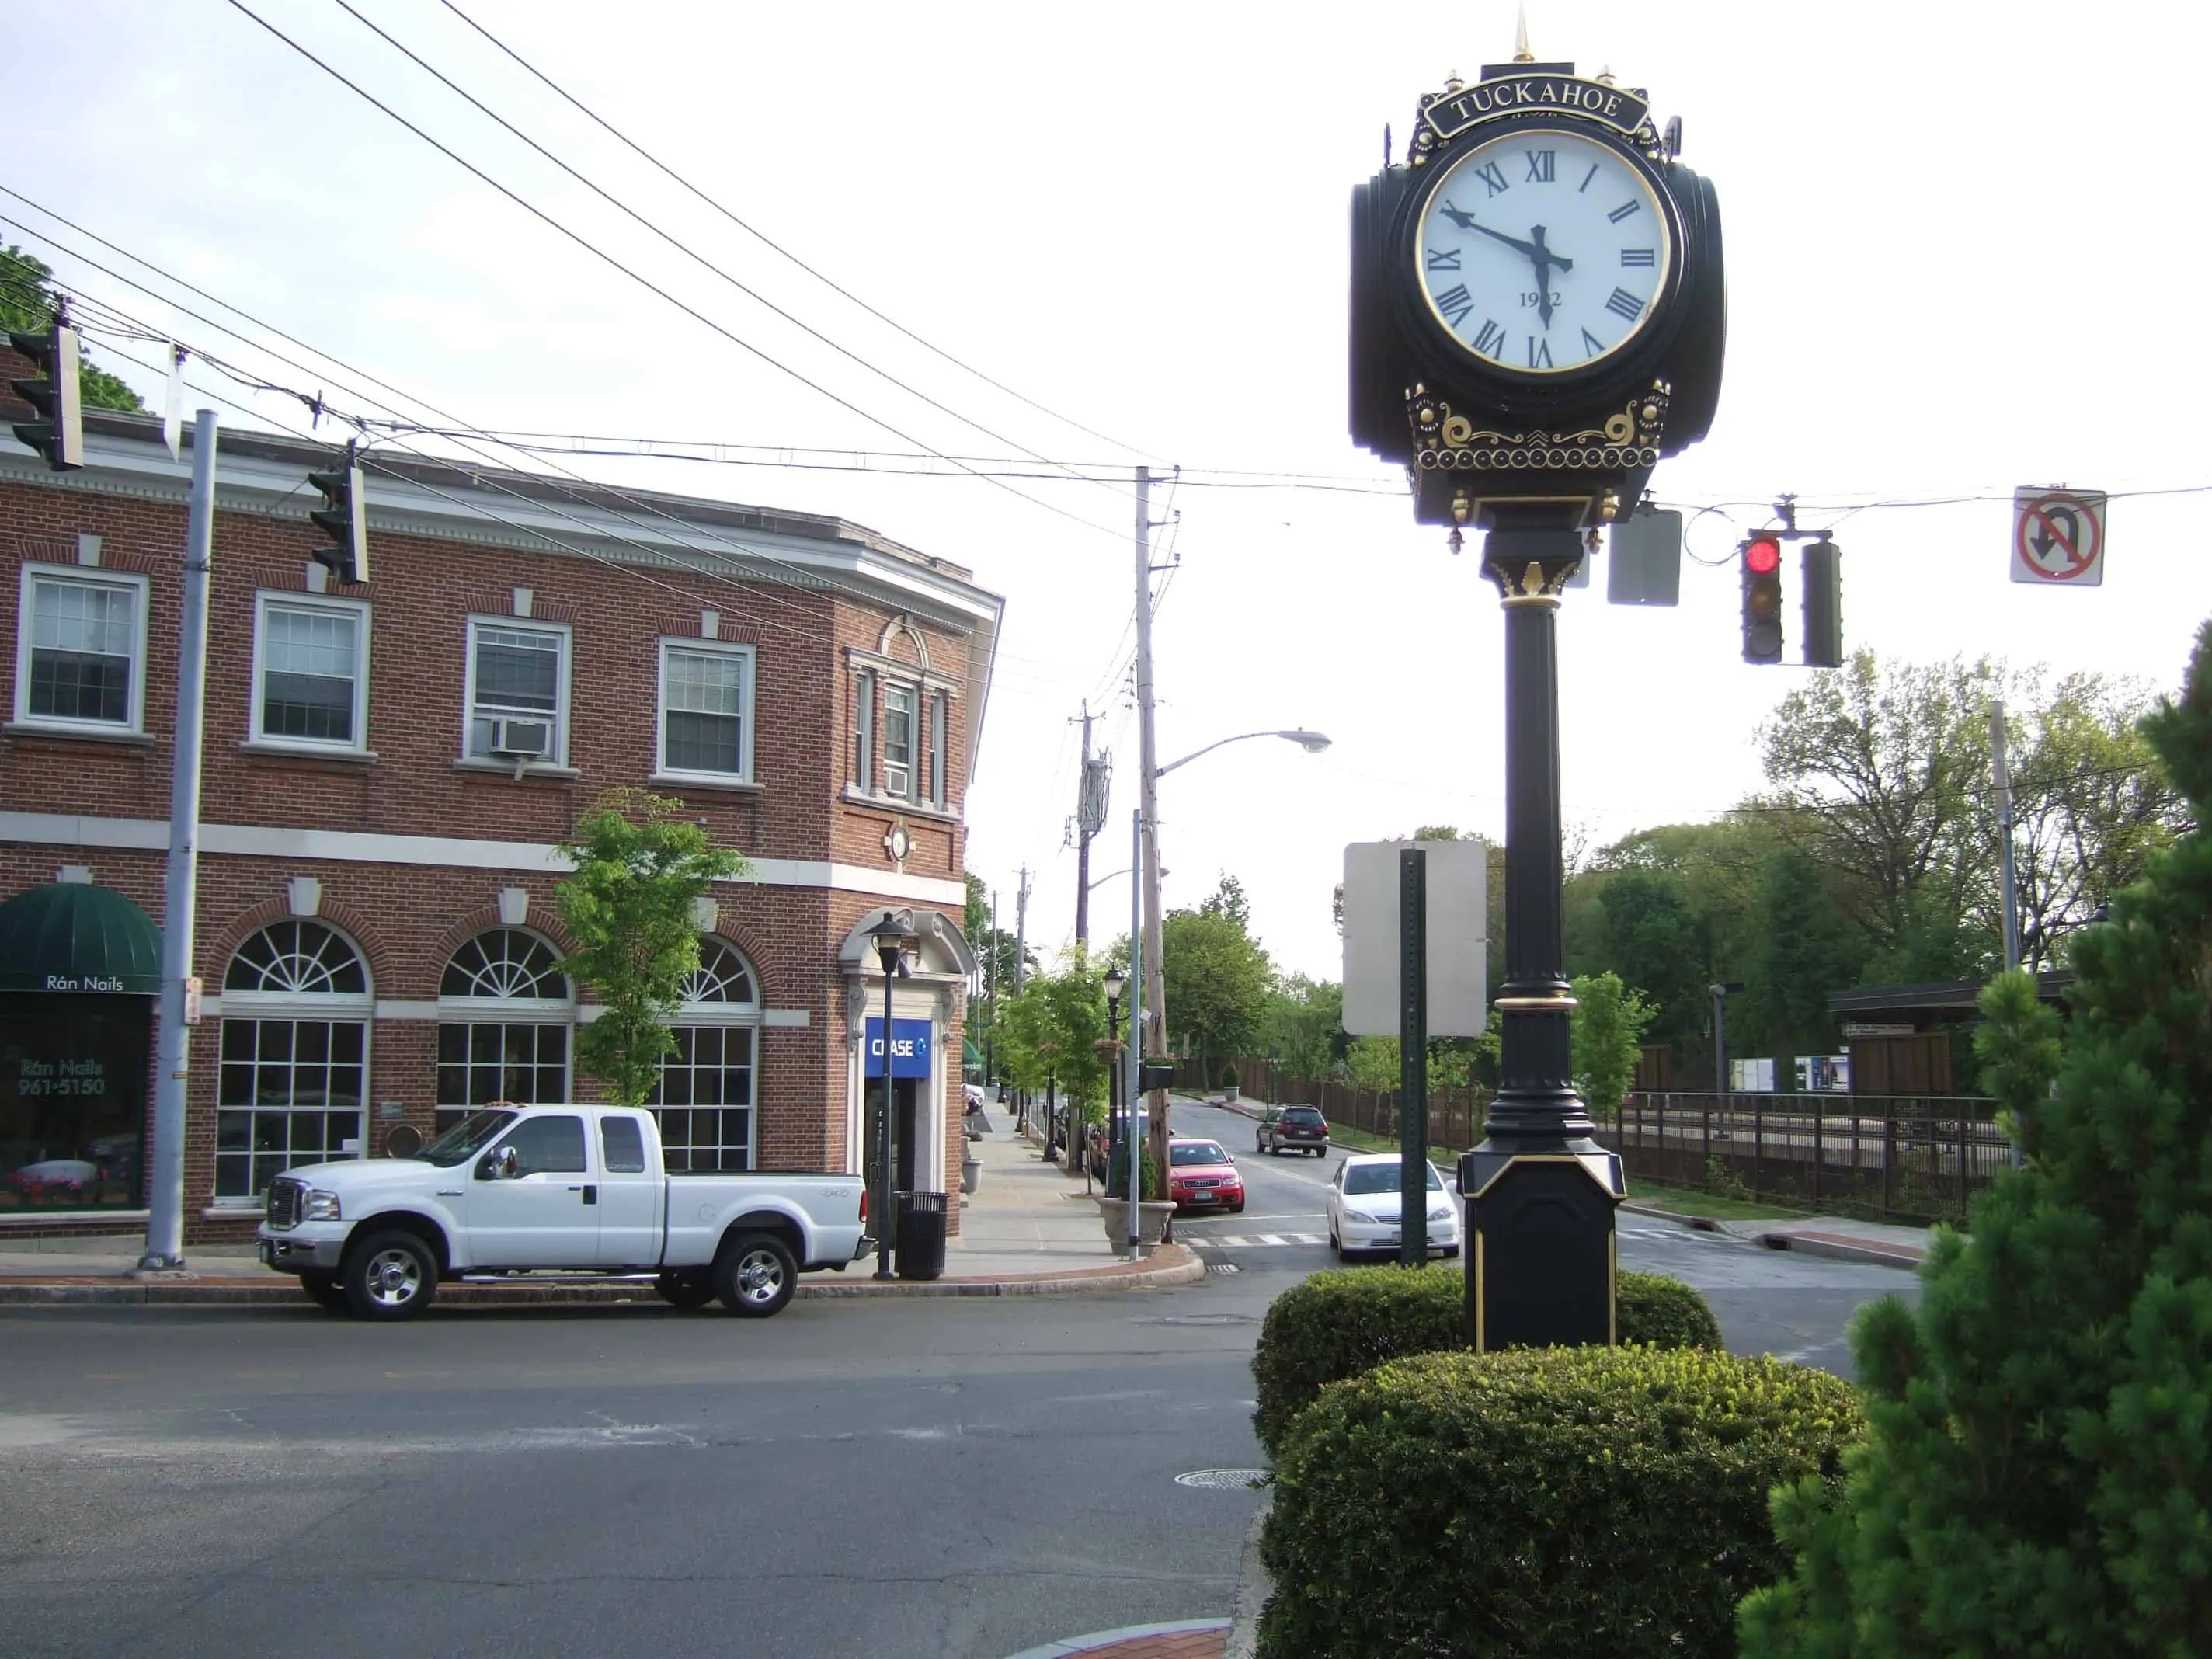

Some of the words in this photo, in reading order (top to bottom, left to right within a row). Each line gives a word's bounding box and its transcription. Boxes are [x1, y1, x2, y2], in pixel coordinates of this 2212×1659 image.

[1450, 82, 1622, 119] TUCKAHOE
[1474, 161, 1510, 198] XI
[1525, 150, 1555, 183] XII
[1608, 199, 1640, 224] II
[1428, 249, 1461, 271] IX
[1621, 248, 1654, 267] III
[1435, 283, 1474, 329] VIII
[1520, 292, 1562, 307] 192
[1471, 318, 1506, 360] VII
[1529, 336, 1554, 369] VI
[47, 975, 78, 989] Rán
[84, 976, 123, 991] Nails
[59, 1058, 103, 1076] Nails
